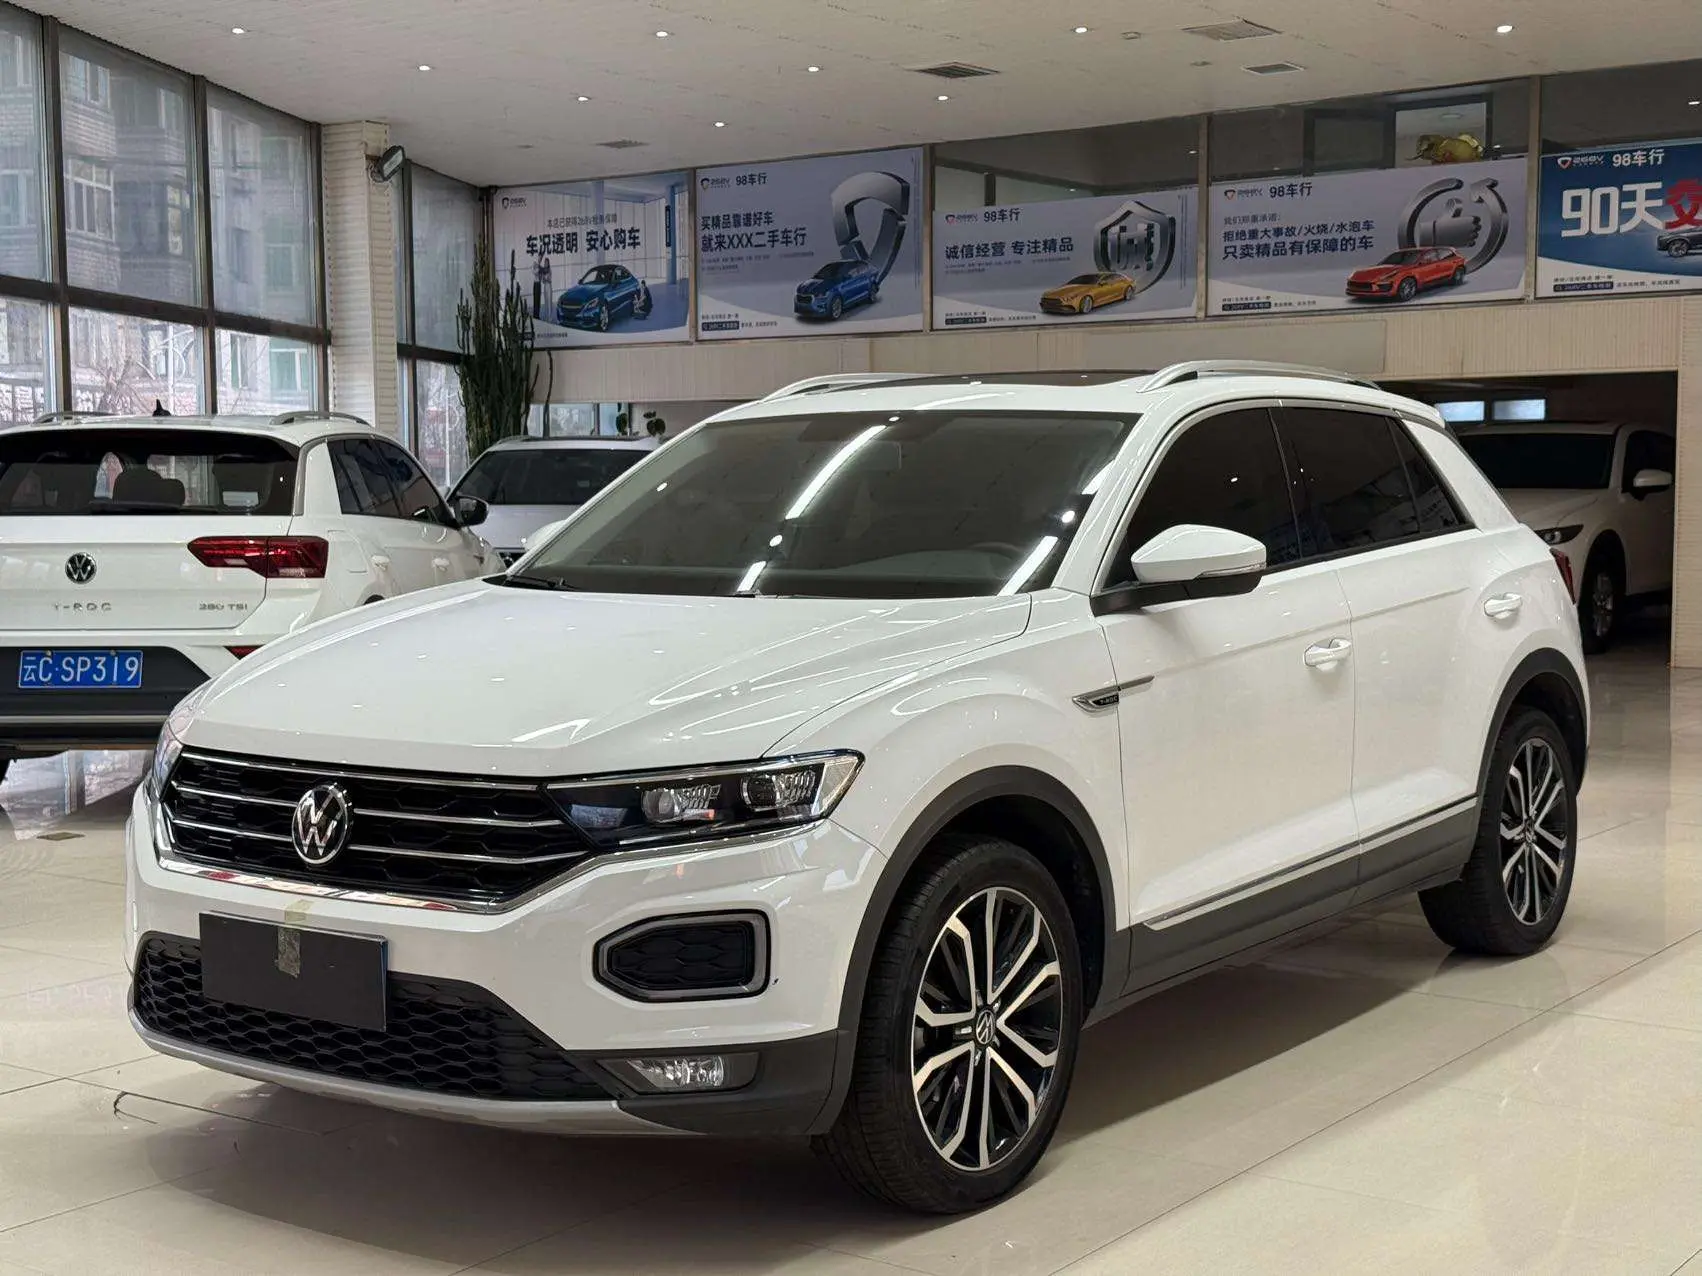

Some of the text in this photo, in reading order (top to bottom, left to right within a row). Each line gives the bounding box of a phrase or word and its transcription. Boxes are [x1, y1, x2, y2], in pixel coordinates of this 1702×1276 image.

[1612, 149, 1665, 167] 98车行
[736, 172, 767, 186] 98车行
[1269, 182, 1313, 198] 98车行
[701, 211, 774, 231] 买精品靠谱好车
[984, 207, 1020, 223] 98车行
[526, 227, 641, 256] 车况透明 安心购车
[701, 227, 807, 252] 就来XXX二手车行
[945, 237, 1074, 260] 诚信经营 专注精品
[1222, 235, 1374, 260] 只卖精品有保障的车
